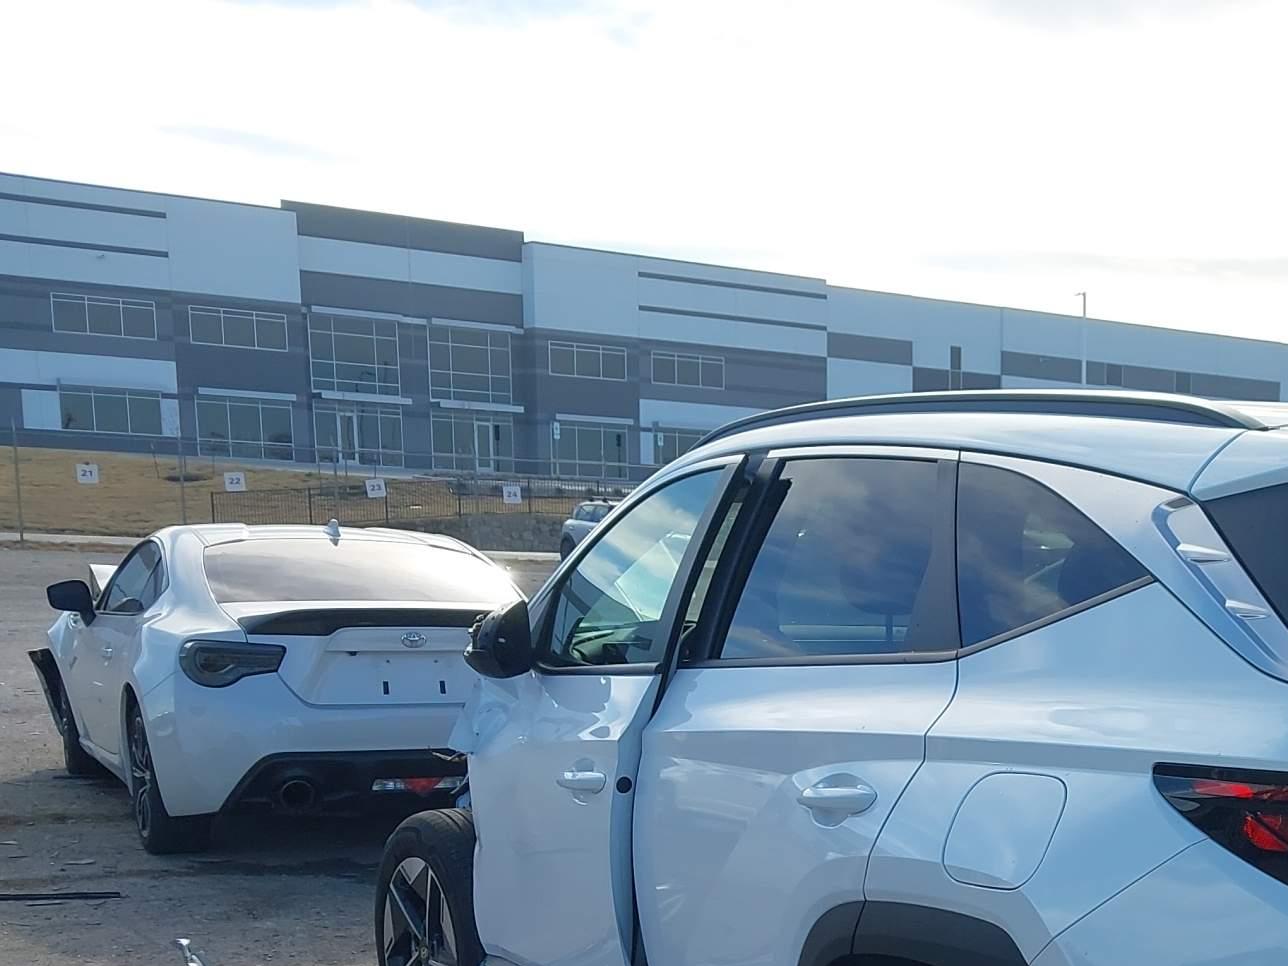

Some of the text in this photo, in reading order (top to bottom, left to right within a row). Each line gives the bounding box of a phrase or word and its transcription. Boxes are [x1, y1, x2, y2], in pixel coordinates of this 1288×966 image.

[80, 469, 93, 477] 21
[229, 477, 241, 485] 22
[506, 490, 518, 498] 24
